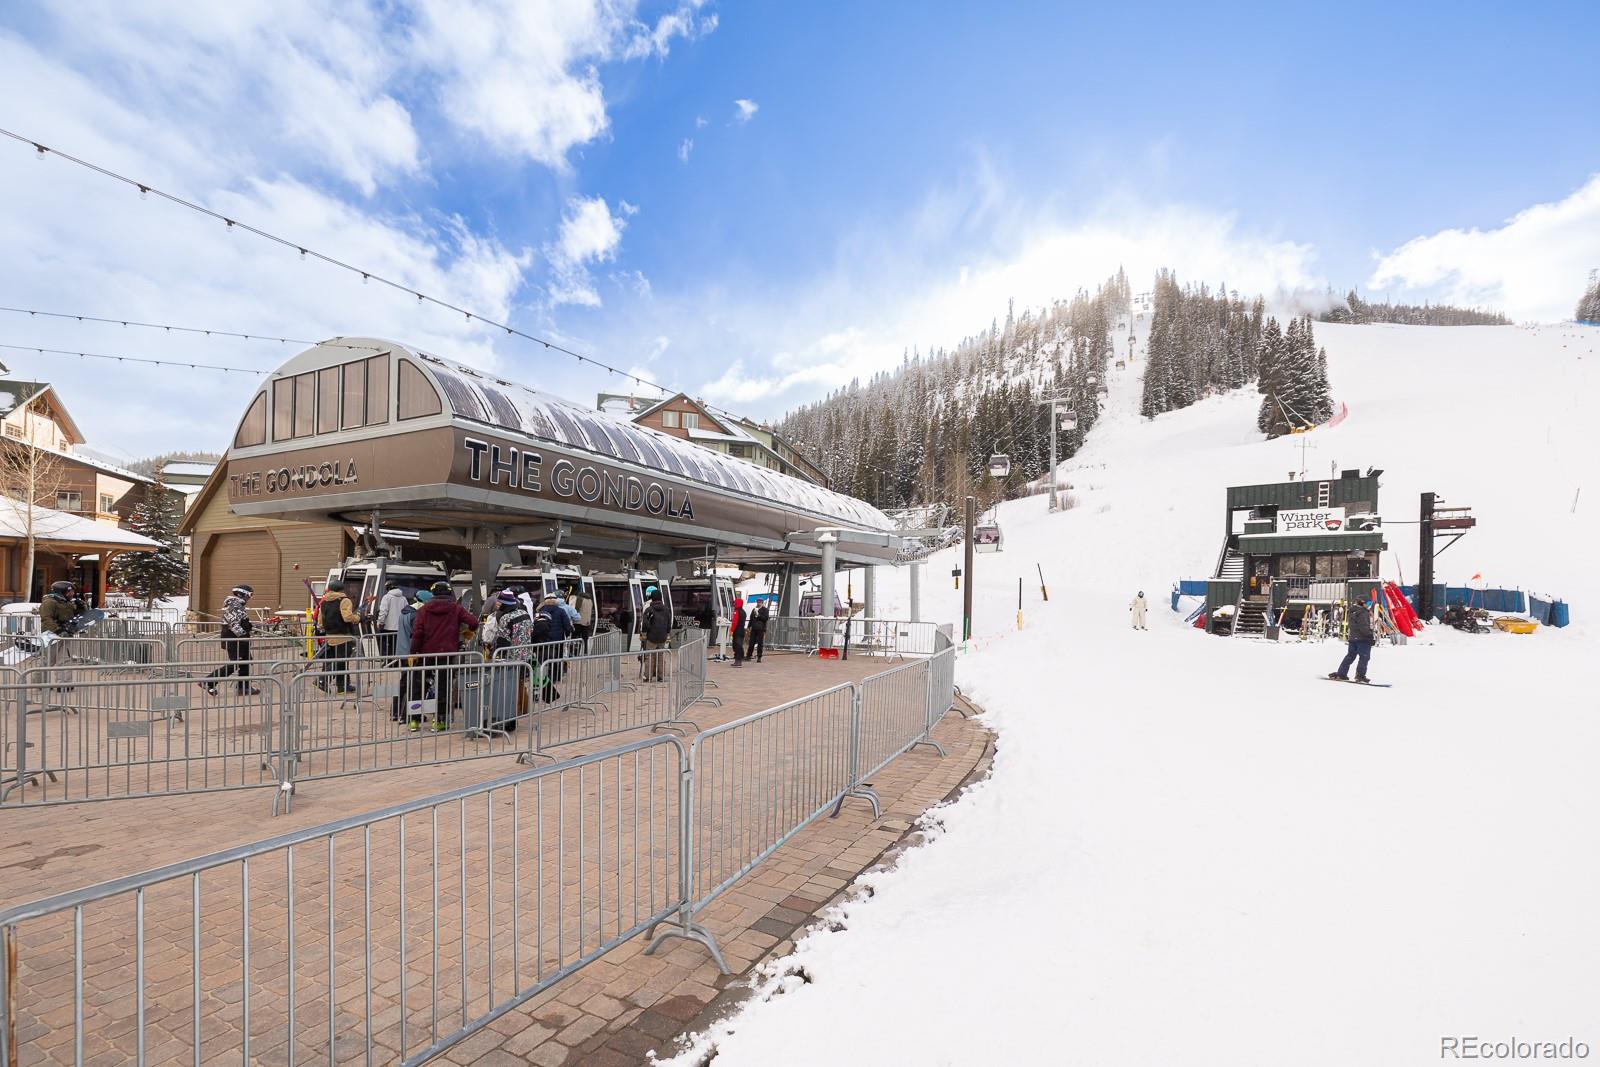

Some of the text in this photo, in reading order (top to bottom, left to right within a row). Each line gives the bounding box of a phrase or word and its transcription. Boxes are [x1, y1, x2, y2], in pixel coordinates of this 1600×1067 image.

[230, 457, 358, 498] THE GONDOLA
[464, 436, 695, 521] THE GONDOLA
[1280, 513, 1331, 521] Winter
[1285, 520, 1325, 531] park
